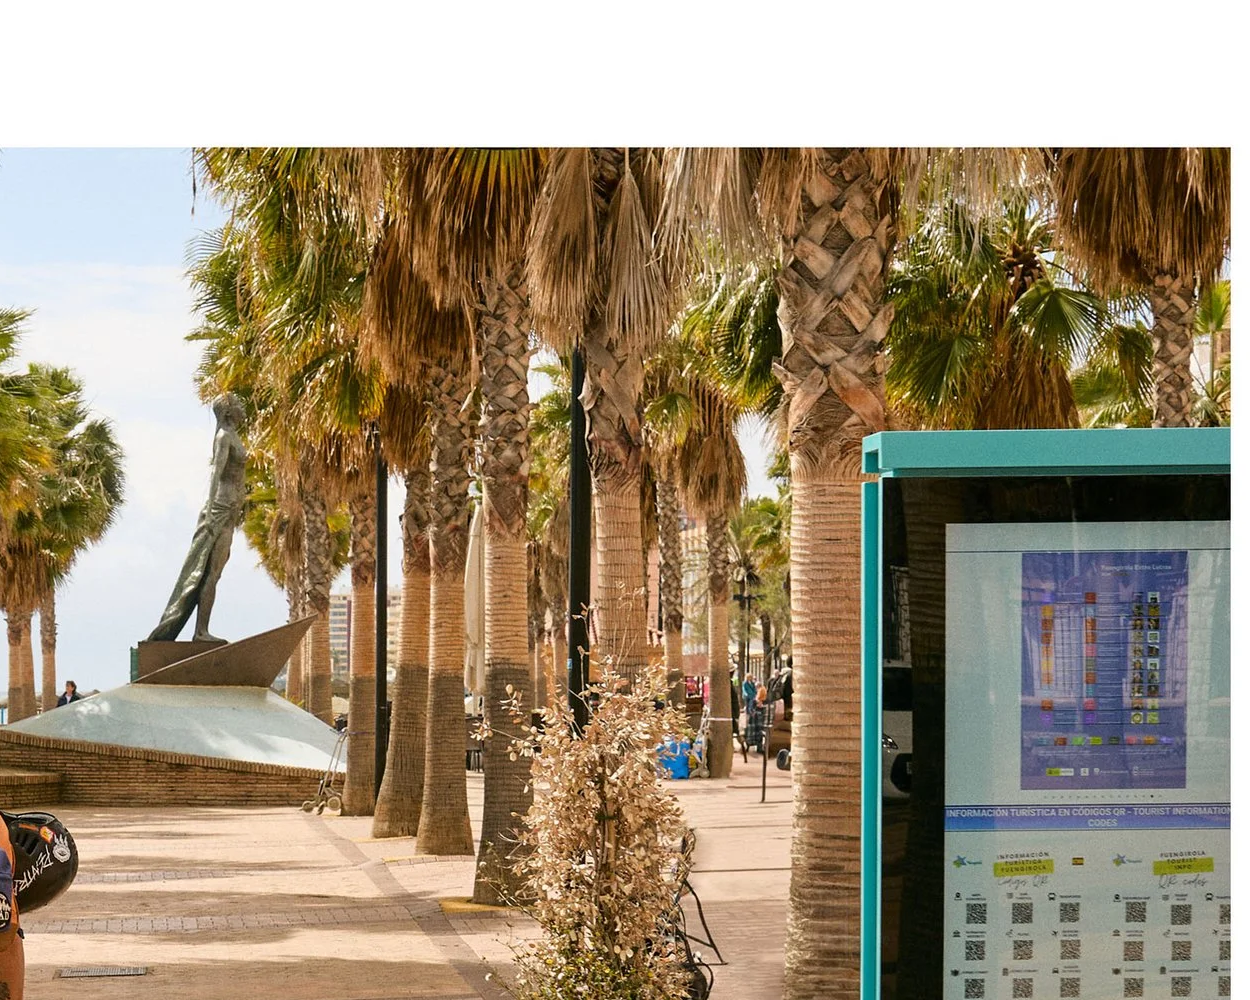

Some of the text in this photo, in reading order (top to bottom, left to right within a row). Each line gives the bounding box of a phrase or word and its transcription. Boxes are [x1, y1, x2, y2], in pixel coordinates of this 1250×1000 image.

[946, 807, 1008, 817] INFORMACIÓN
[1011, 806, 1056, 817] TURÍSTICA
[1058, 808, 1070, 816] EN
[1072, 806, 1111, 816] CÓDIGOS
[1112, 807, 1126, 817] QR
[1133, 807, 1170, 816] TOURIST
[1088, 818, 1118, 827] CODES
